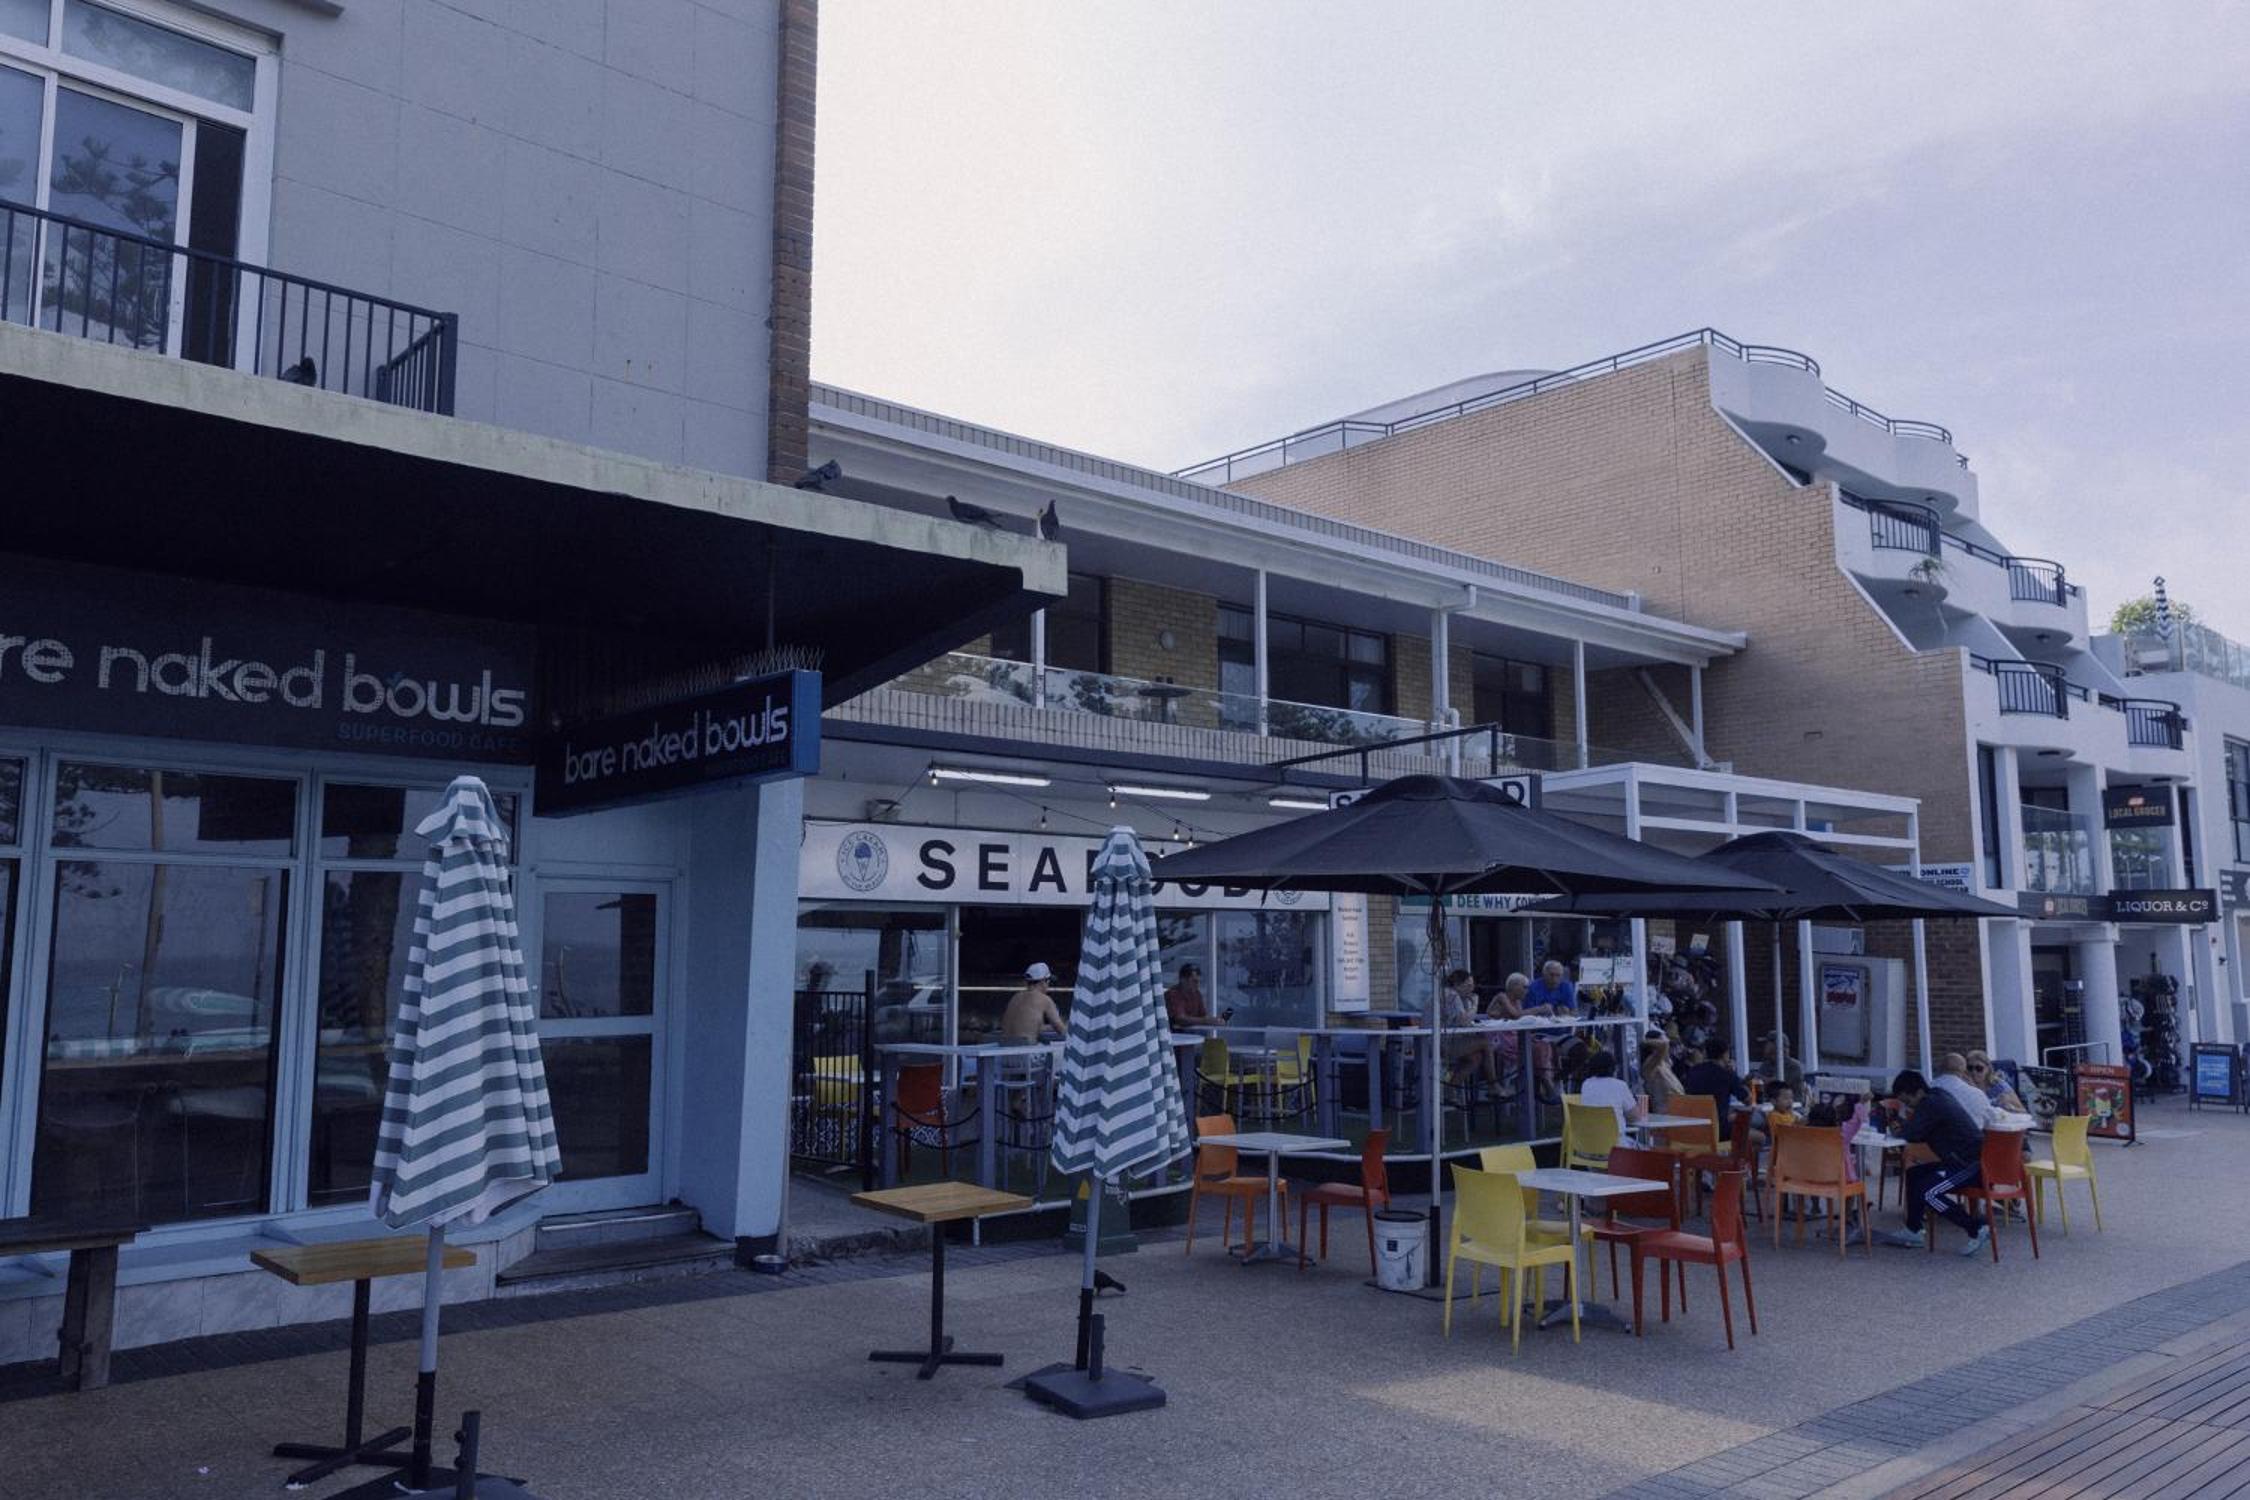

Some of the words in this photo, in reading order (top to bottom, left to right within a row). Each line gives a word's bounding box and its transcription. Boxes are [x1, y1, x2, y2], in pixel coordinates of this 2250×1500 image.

[97, 636, 325, 710] naked
[342, 653, 525, 728] bowls
[336, 723, 464, 748] SUPERFOOD
[564, 743, 616, 784] bare
[621, 711, 698, 772] naked
[705, 695, 788, 757] bowls
[1457, 896, 1480, 908] DEE
[1483, 896, 1511, 909] WHY
[2116, 900, 2173, 913] LIQUOR
[2175, 900, 2187, 912] &
